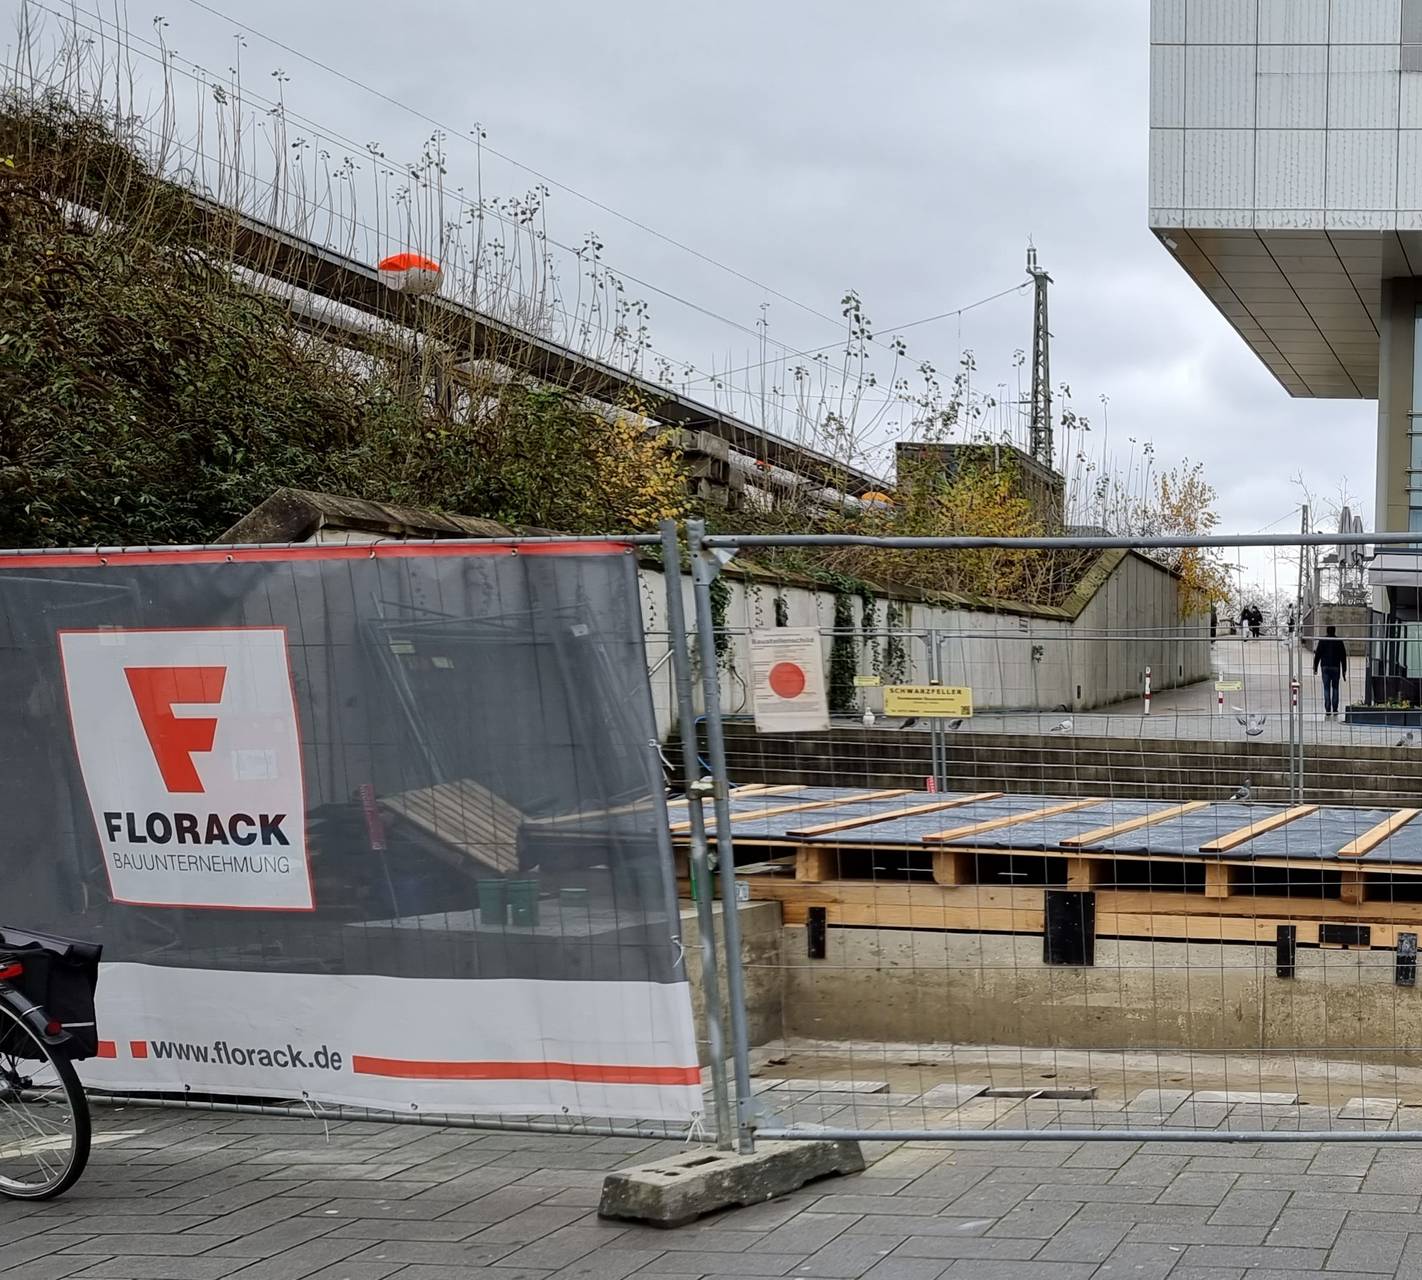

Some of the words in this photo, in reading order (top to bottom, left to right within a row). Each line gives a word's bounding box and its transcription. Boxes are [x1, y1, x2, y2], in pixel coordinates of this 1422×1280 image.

[889, 687, 962, 695] SCHWARZFELLER
[103, 812, 290, 846] FLORACK
[112, 853, 290, 874] BAUUNTERNEHMUNG
[150, 1041, 342, 1071] www.florack.de
